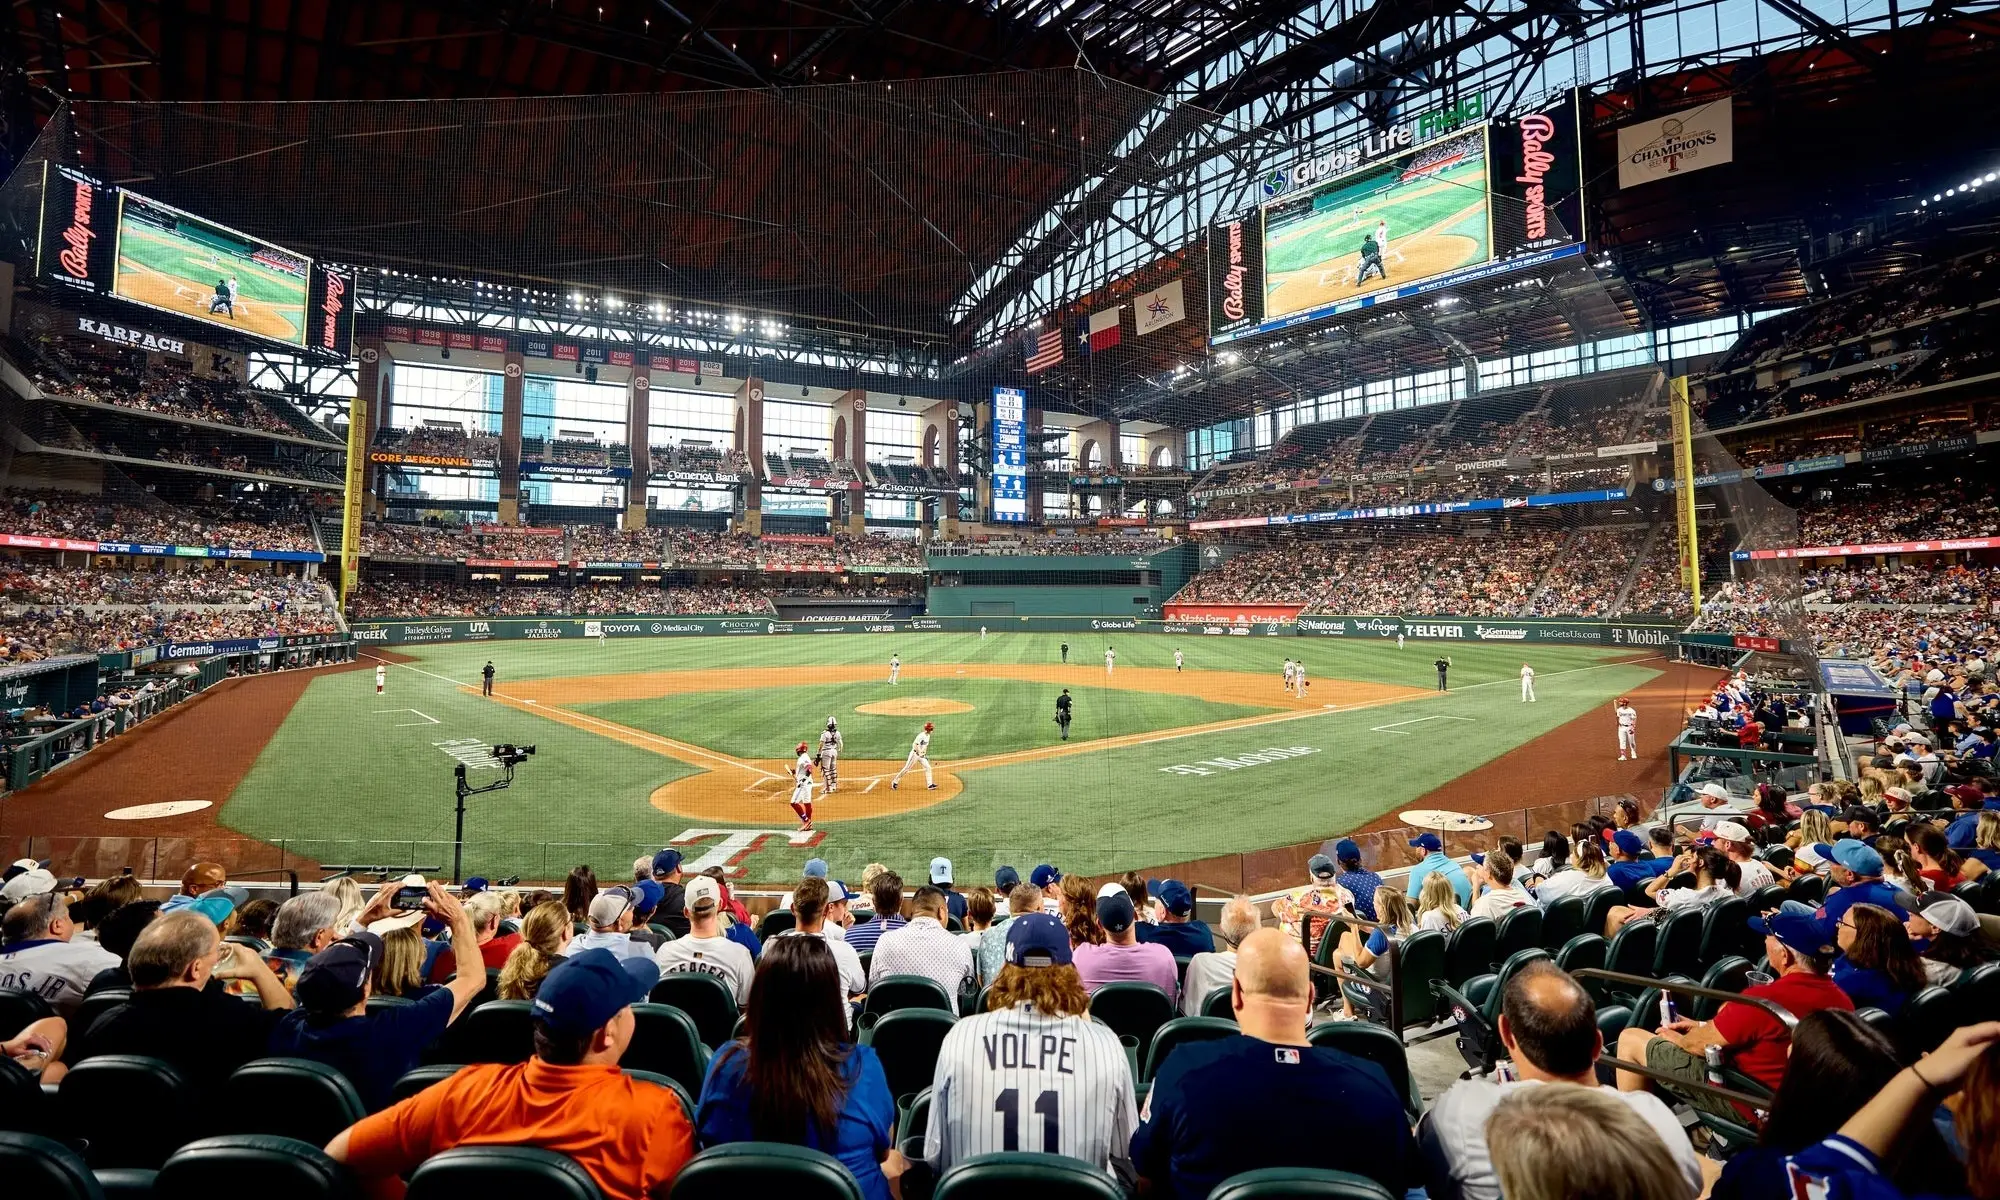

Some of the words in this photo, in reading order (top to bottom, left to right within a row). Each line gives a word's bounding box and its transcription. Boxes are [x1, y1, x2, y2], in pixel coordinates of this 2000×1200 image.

[1293, 146, 1360, 186] Globe
[1364, 125, 1413, 158] Life
[1418, 94, 1484, 138] Field
[1515, 113, 1555, 184] Bally
[1631, 133, 1717, 164] CHAMPIONS
[74, 182, 93, 224] SPORTS
[1525, 182, 1546, 240] SPORTS
[1229, 222, 1242, 265] SPORTS
[60, 222, 97, 279] Bally
[1417, 281, 1445, 292] WYATT
[1444, 270, 1486, 285] LANGFORD
[1486, 264, 1511, 275] LINED
[1511, 261, 1523, 269] TO
[1523, 253, 1554, 266] SHORT
[321, 270, 344, 318] Bally
[1223, 264, 1248, 320] Bally
[1144, 313, 1174, 329] ARLINGTON
[78, 318, 185, 354] KARPACH
[421, 329, 441, 339] 1998
[452, 334, 471, 342] 1999
[483, 337, 502, 345] 2010
[528, 342, 546, 351] 2010
[558, 345, 575, 353] 2011
[362, 351, 376, 360] 42
[613, 351, 631, 359] 2012
[507, 366, 520, 375] 34
[703, 362, 720, 370] 2023
[636, 379, 648, 388] 26
[754, 390, 760, 399] 7
[855, 401, 865, 409] 29
[1673, 403, 1683, 436] THE
[1937, 437, 1969, 447] PERRY
[1866, 449, 1893, 458] PERRY
[1901, 443, 1929, 453] PERRY
[371, 453, 402, 463] CORE
[403, 455, 473, 467] PERSONNEL
[1546, 453, 1559, 461] Real
[1561, 452, 1575, 460] fans
[1676, 445, 1686, 479] HOT
[539, 466, 576, 474] LOCKHEED
[1455, 459, 1508, 472] POWERADE
[715, 473, 740, 483] Bank
[1350, 474, 1369, 482] PGL
[352, 473, 361, 504] THE
[885, 484, 926, 494] CHOCTAW
[1201, 490, 1214, 498] UT
[1215, 486, 1255, 497] DALLAS
[1678, 488, 1689, 534] ZONE
[350, 506, 360, 550] HEAT
[1860, 545, 1904, 553] Budweiser
[1941, 539, 1989, 549] Budweiser
[470, 622, 490, 633] UTA
[602, 624, 641, 633] TOYOTA
[663, 624, 690, 632] Medical
[690, 624, 705, 634] City
[352, 628, 388, 640] ATGEEK
[1539, 629, 1601, 640] HeGetsUs.com
[1612, 628, 1623, 643] T
[1626, 629, 1670, 645] Mobile
[168, 643, 215, 659] Germania
[1194, 746, 1322, 770] Mobile
[939, 864, 947, 875] T
[983, 1032, 1077, 1076] VOLPE
[994, 1088, 1060, 1154] 11
